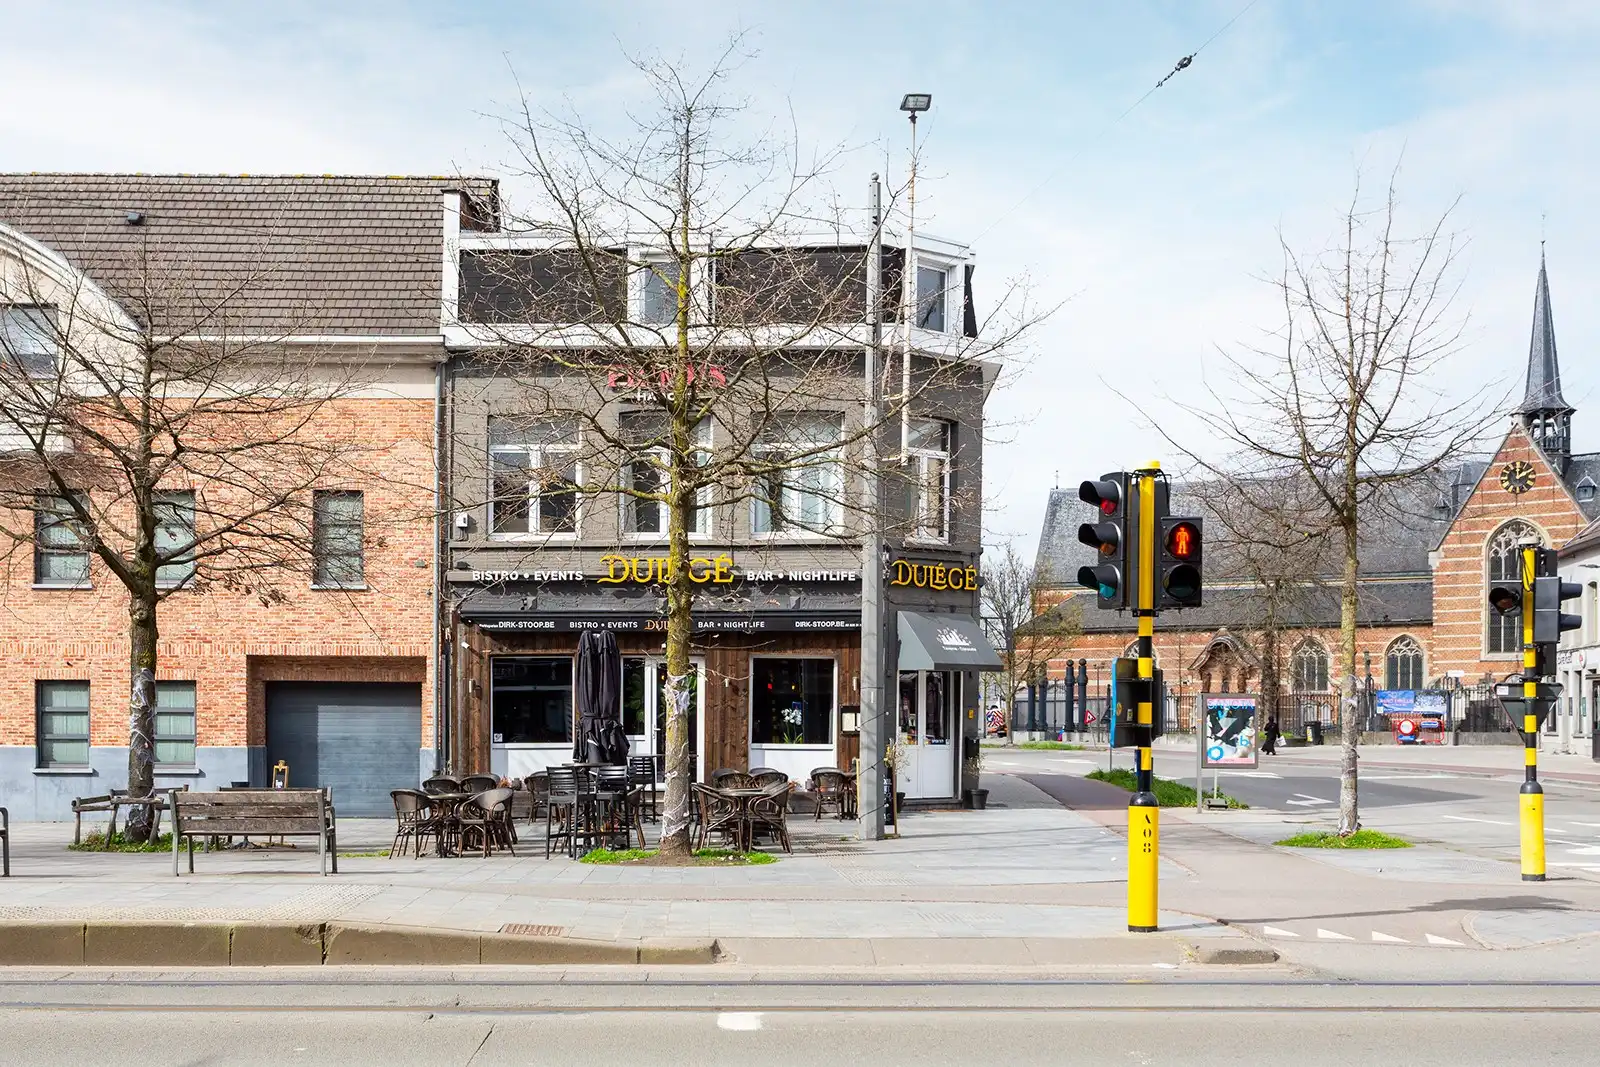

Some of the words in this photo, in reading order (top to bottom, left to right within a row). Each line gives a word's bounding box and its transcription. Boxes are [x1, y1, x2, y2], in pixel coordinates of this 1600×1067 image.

[597, 553, 735, 584] DULGÉ
[472, 570, 519, 581] BISTRO
[534, 570, 584, 581] EVENTS
[746, 571, 774, 581] BAR
[788, 571, 857, 581] NIGHTLIFE
[498, 621, 555, 629] DIRK-STOOP.BE
[569, 621, 599, 629] BISTRO
[607, 621, 639, 629] EVENTS
[723, 621, 766, 629] NIGHTLIFE
